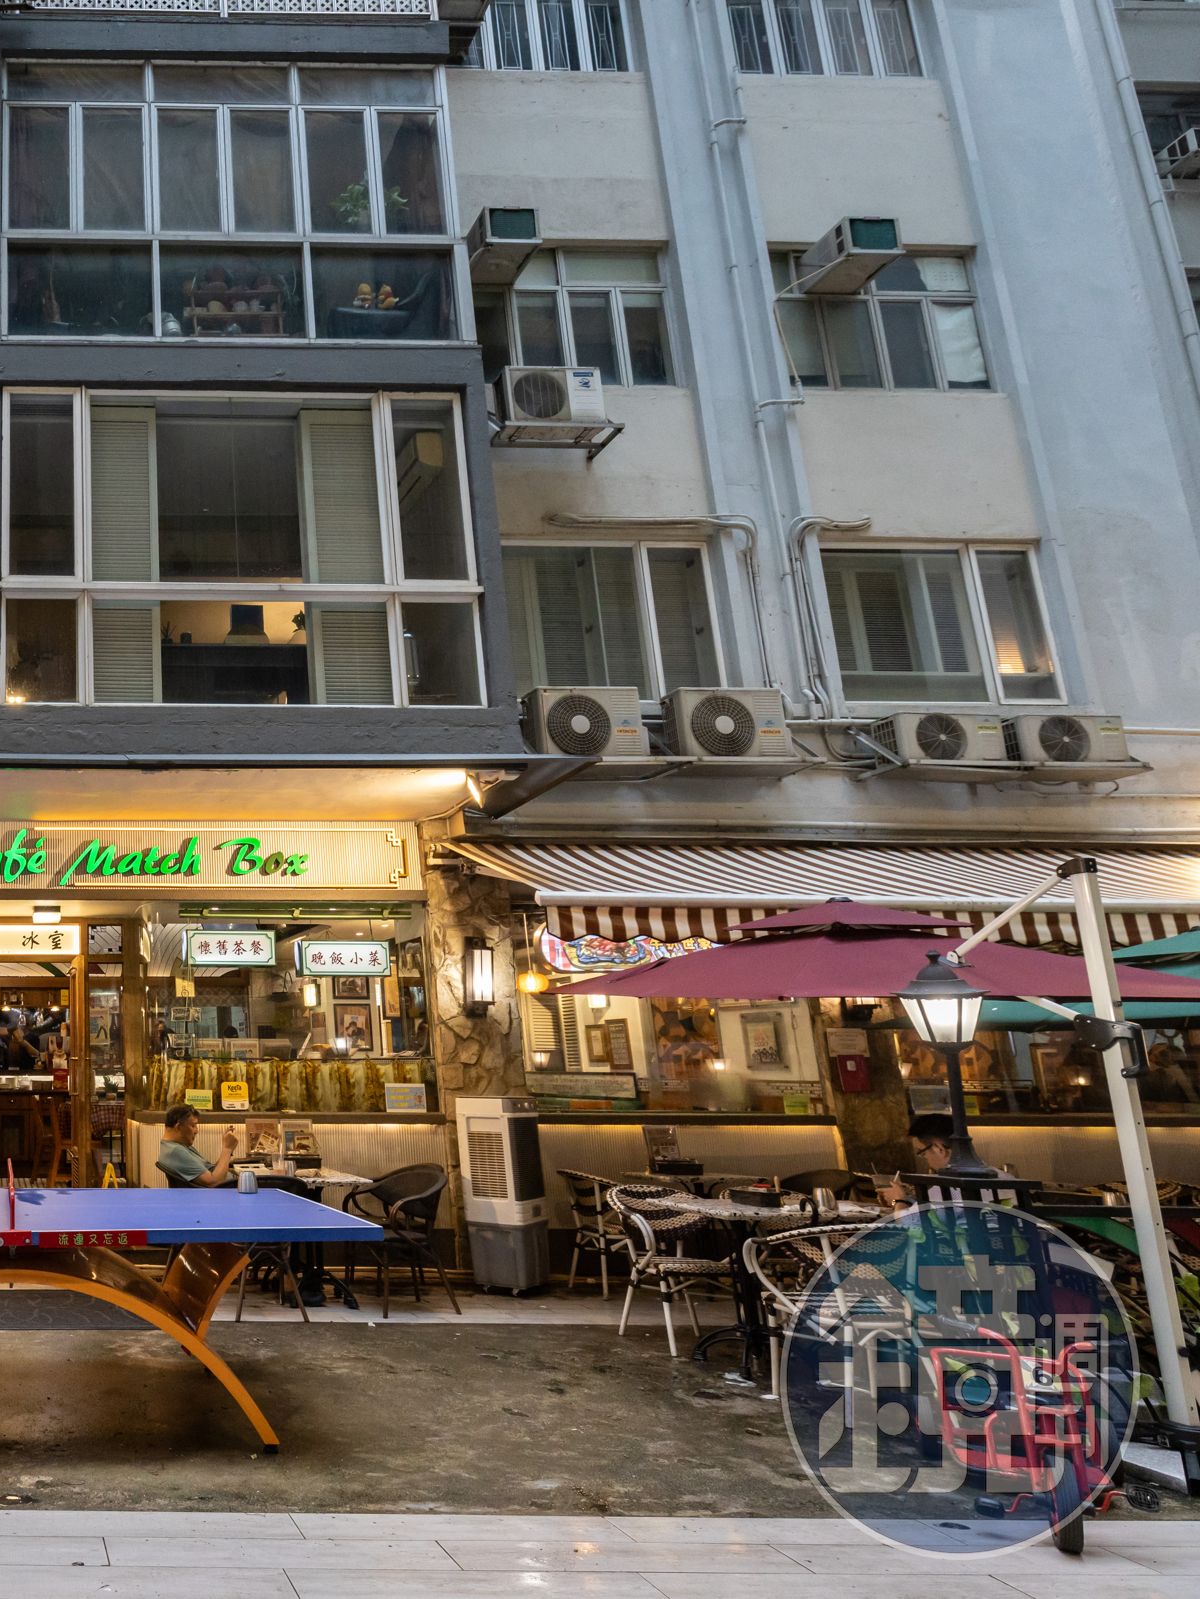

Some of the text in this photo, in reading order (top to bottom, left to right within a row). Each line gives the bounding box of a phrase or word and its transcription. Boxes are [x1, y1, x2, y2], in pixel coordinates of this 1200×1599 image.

[60, 836, 201, 886] Match
[217, 836, 309, 876] Box
[198, 939, 265, 957] 懷舊茶餐
[310, 950, 382, 967] 晚飯小菜
[58, 1233, 129, 1246] 流連又忘返
